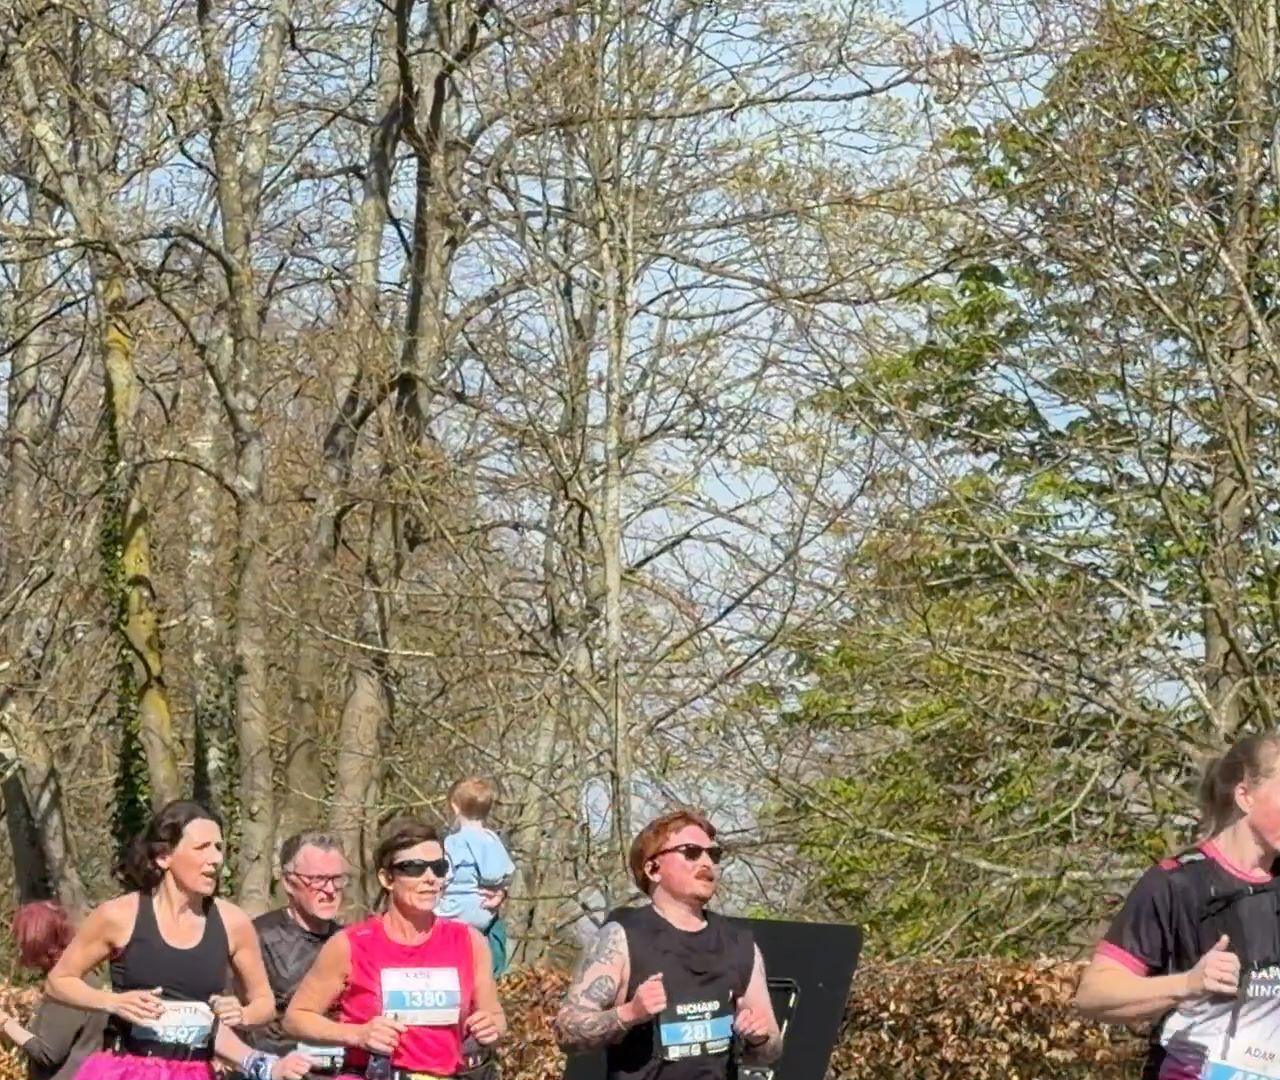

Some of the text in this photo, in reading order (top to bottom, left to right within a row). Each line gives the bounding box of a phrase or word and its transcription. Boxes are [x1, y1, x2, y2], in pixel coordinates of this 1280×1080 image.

[676, 1000, 720, 1015] RICHARD
[681, 1021, 712, 1042] 281
[1245, 1046, 1276, 1062] ADAM
